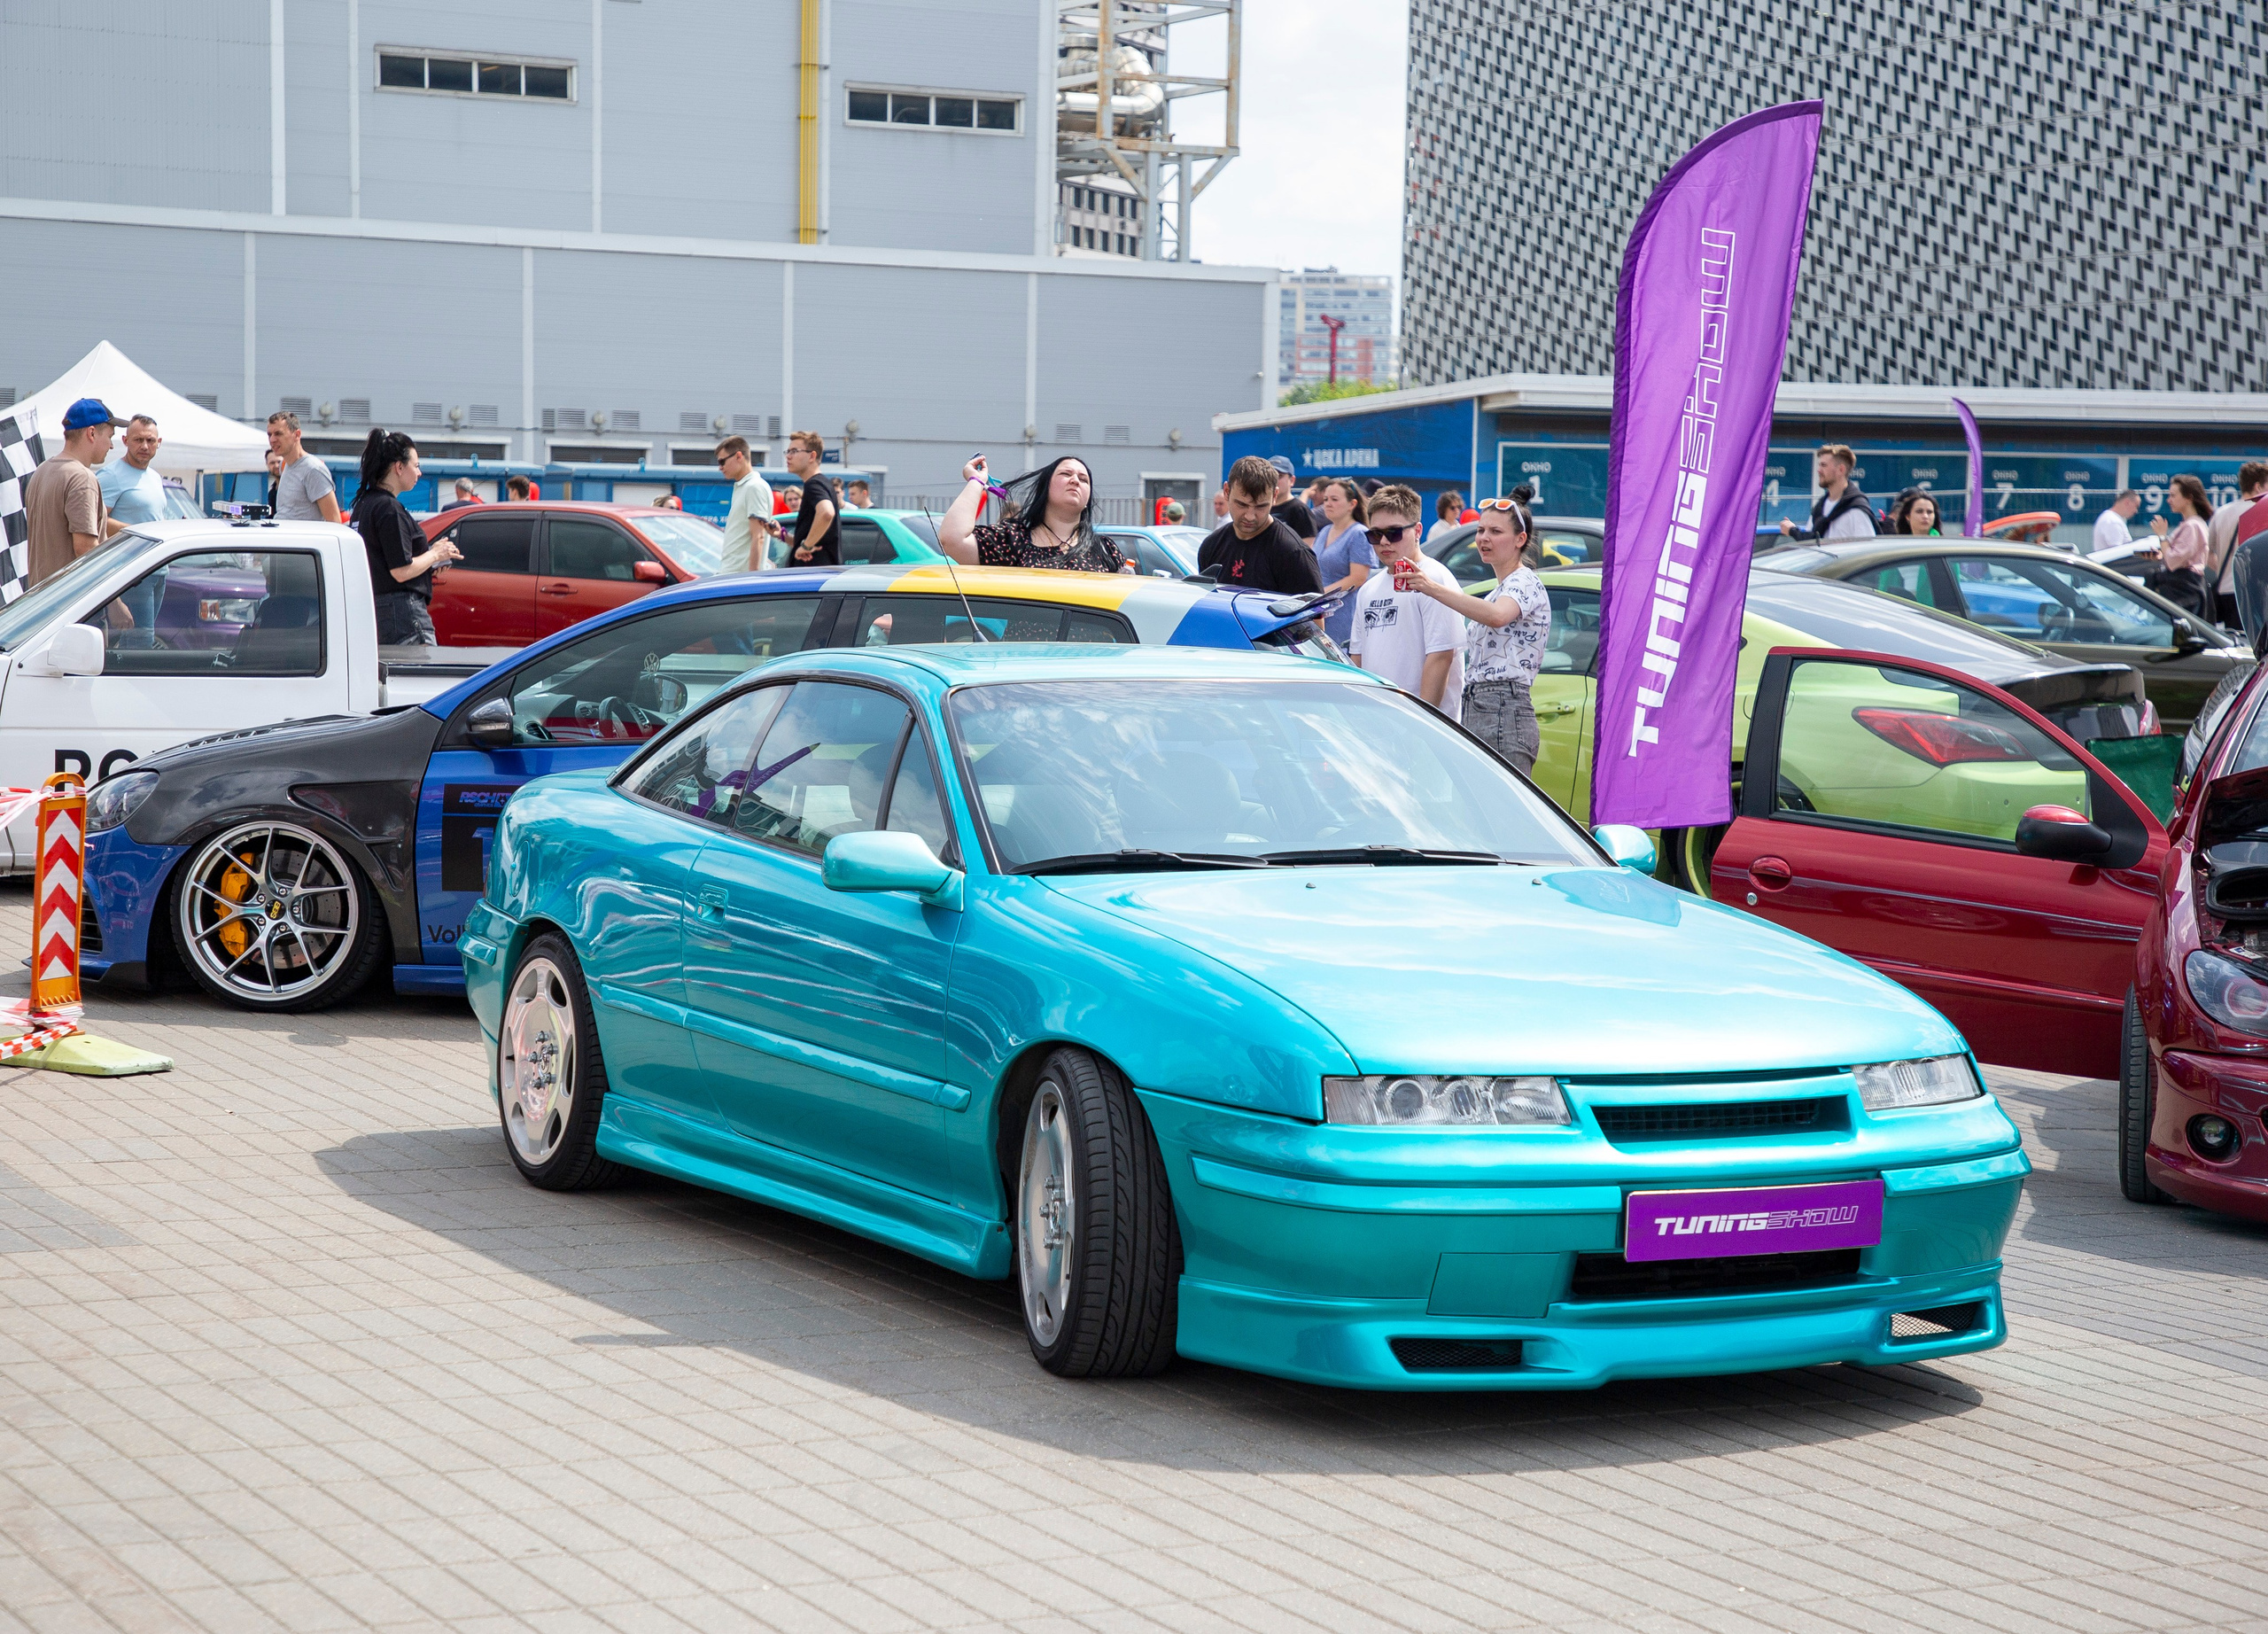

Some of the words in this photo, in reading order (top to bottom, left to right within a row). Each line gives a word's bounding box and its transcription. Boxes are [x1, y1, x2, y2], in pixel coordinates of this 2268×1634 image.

[1313, 448, 1342, 471] ЦСКА
[1521, 462, 1551, 473] ОКНО
[1528, 475, 1544, 504] 1
[1996, 482, 2014, 510] 7
[2067, 483, 2085, 511] 8
[2145, 485, 2163, 513] 9
[1654, 1205, 1859, 1236] TUNINGSHOW
